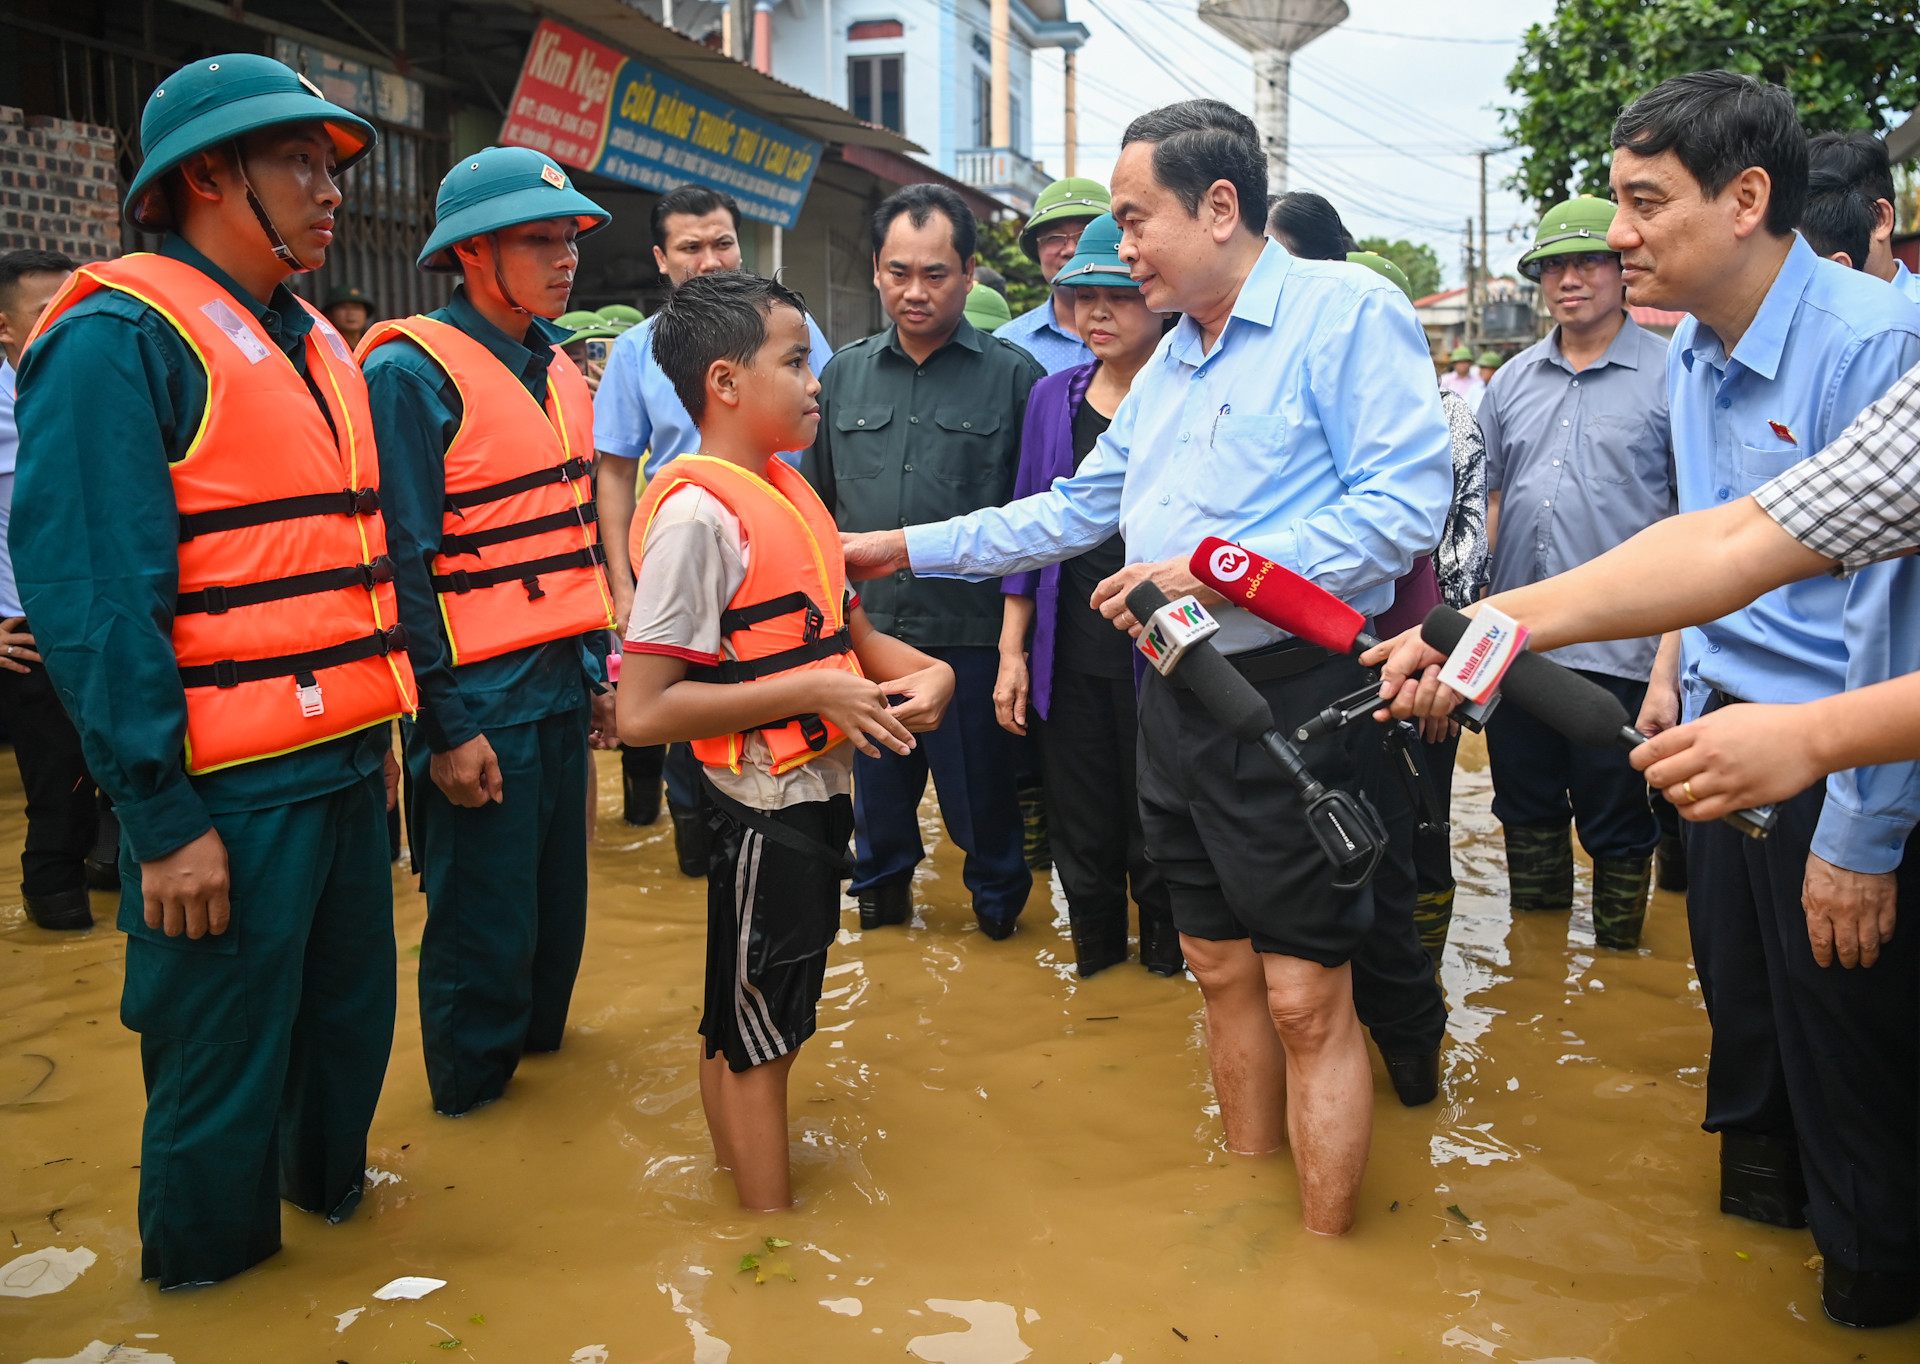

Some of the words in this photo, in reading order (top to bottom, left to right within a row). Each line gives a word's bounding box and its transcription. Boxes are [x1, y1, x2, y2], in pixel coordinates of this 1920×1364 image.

[528, 30, 573, 88] Kim
[569, 47, 611, 112] Nga
[755, 137, 770, 168] Y
[763, 141, 791, 176] CAO
[1246, 573, 1265, 599] QUỐC
[1168, 601, 1205, 628] VTV
[1140, 623, 1167, 661] VTV
